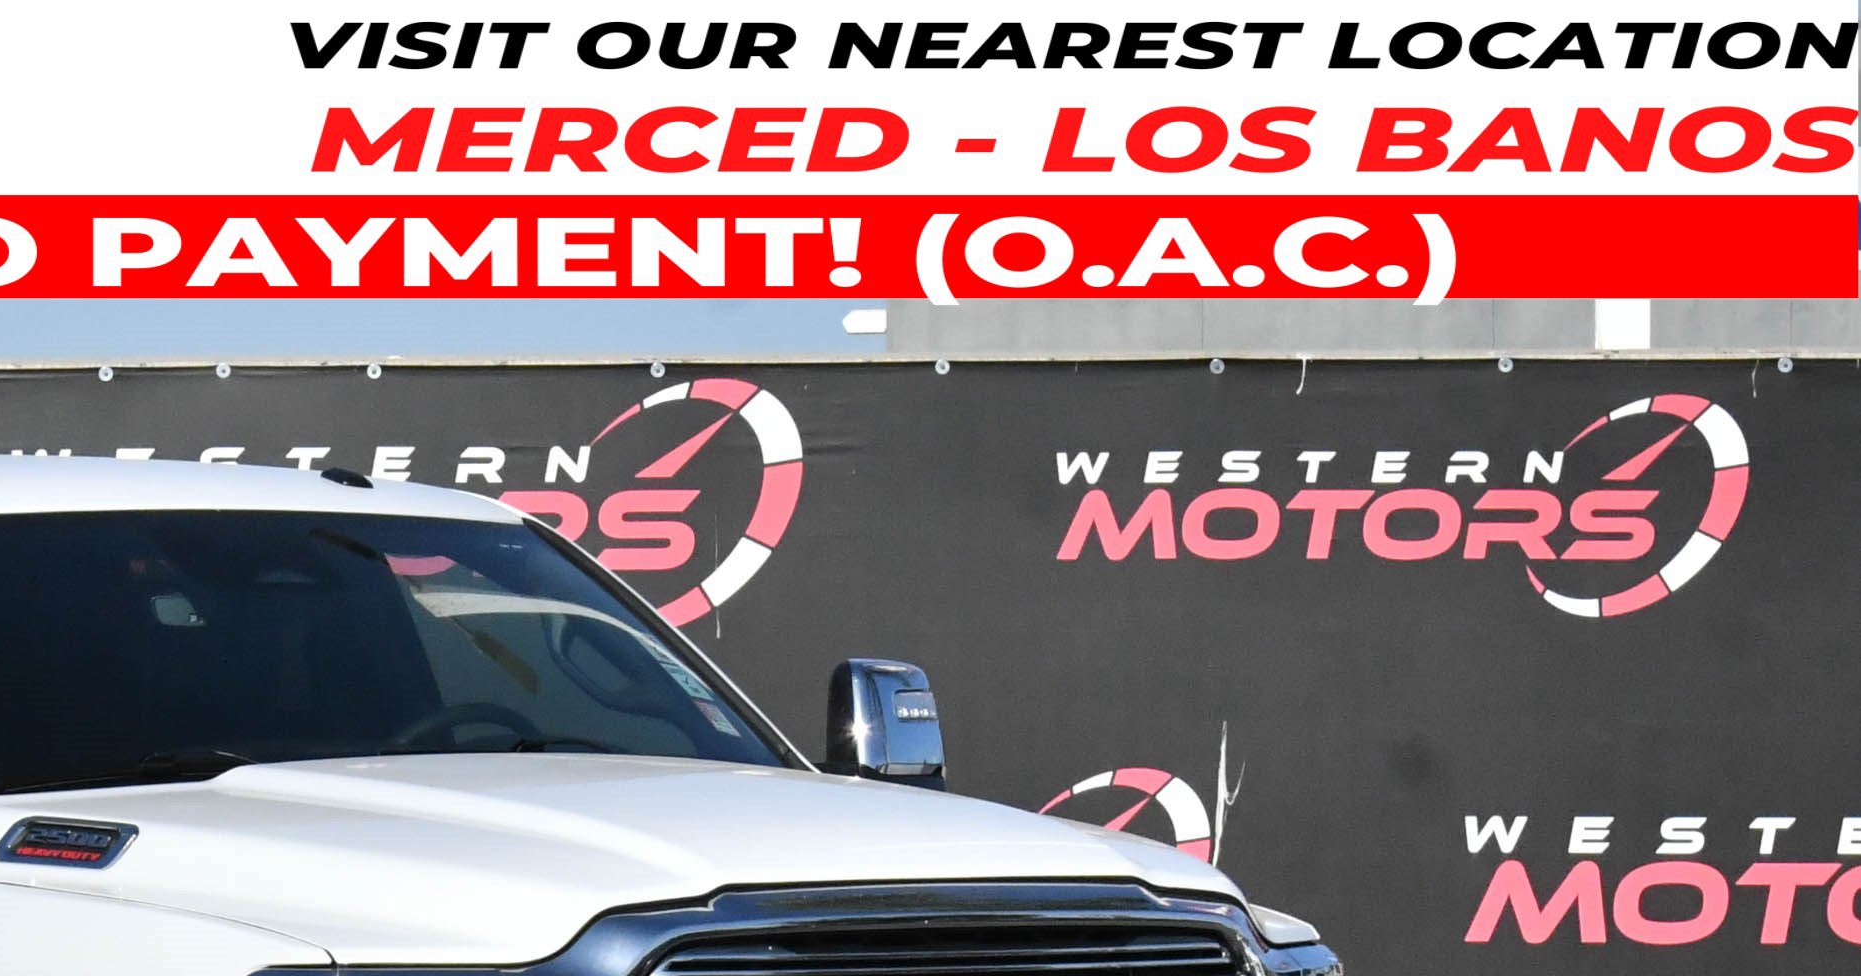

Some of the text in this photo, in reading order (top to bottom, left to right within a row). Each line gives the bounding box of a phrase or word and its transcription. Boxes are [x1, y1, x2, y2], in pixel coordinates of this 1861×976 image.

[1056, 450, 1565, 485] WESTERN
[1055, 488, 1660, 571] MOTORS
[25, 828, 112, 848] 2500
